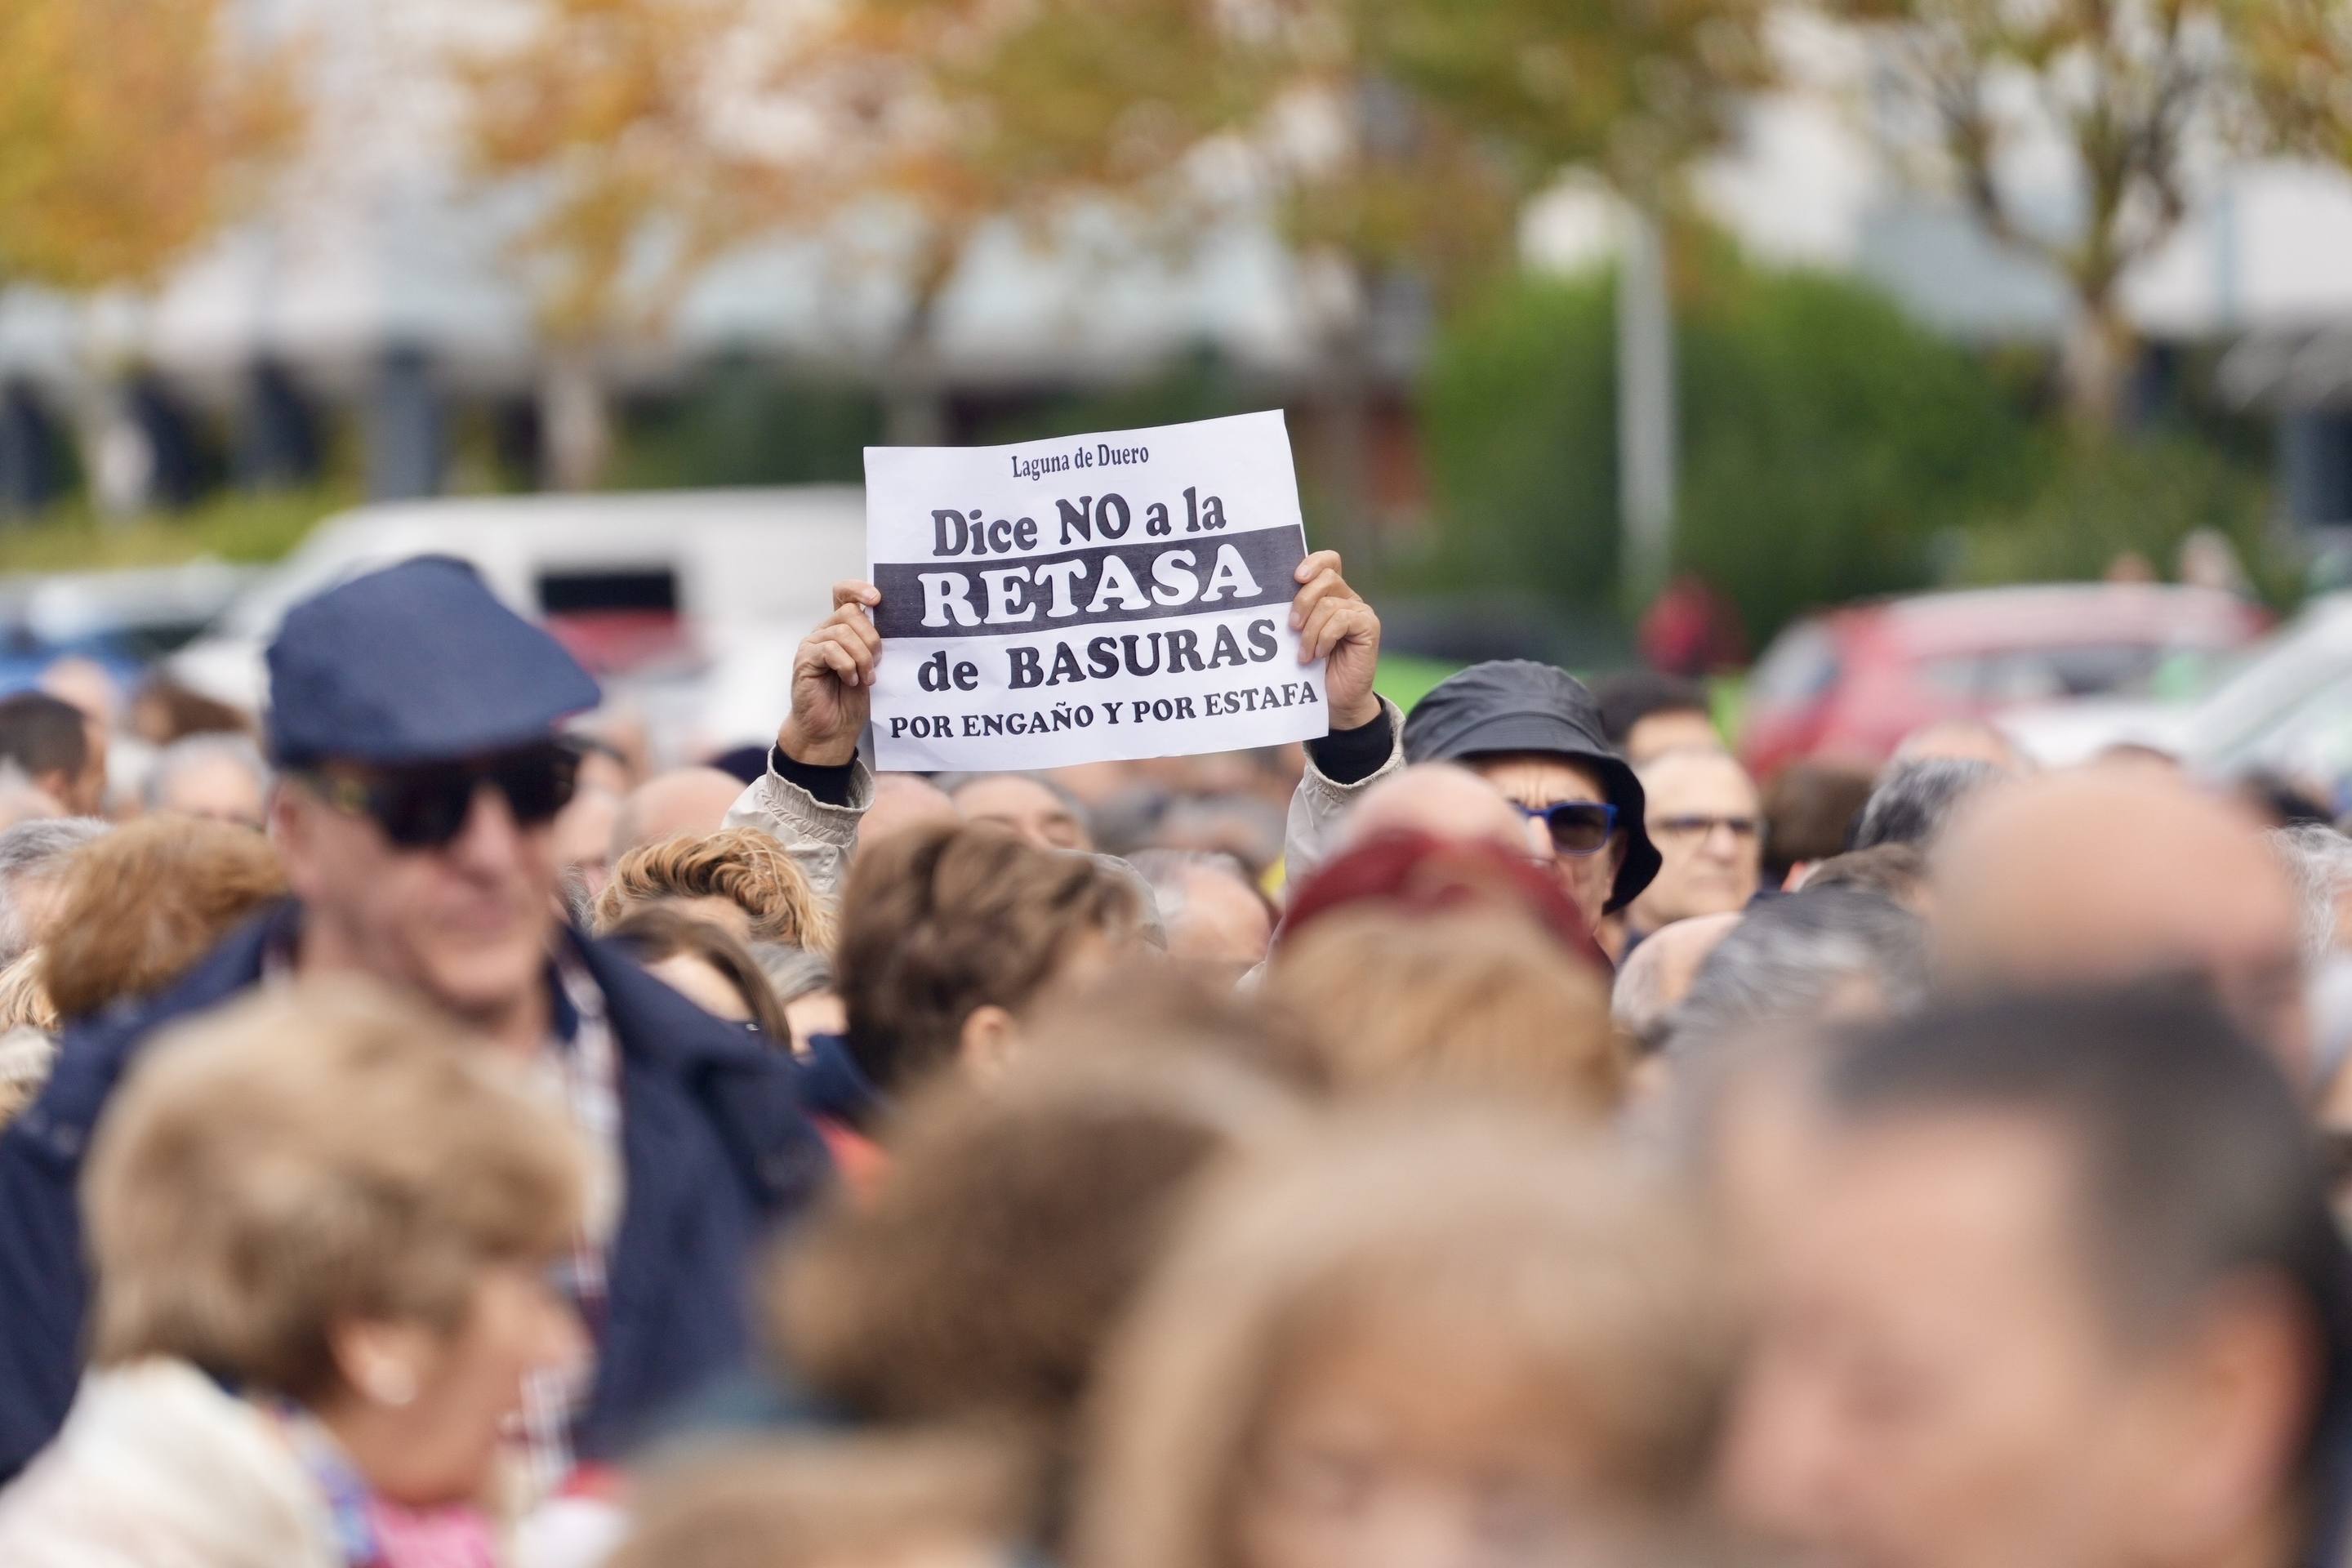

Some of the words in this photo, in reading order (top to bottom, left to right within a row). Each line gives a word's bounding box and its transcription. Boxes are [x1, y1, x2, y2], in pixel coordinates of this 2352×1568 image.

[1012, 455, 1069, 481] Laguna
[1075, 447, 1093, 469] de
[1098, 444, 1148, 466] Duero
[932, 510, 1037, 556] Dice
[1056, 493, 1130, 545] NO
[1146, 503, 1171, 536] a
[1183, 487, 1226, 532] la
[918, 544, 1262, 627] RETASA
[918, 650, 978, 692] de
[1006, 620, 1277, 689] BASURAS
[889, 716, 954, 738] POR
[961, 702, 1094, 737] ENGAÑO
[1102, 702, 1123, 724] Y
[1132, 697, 1196, 723] POR
[1204, 681, 1318, 716] ESTAFA
